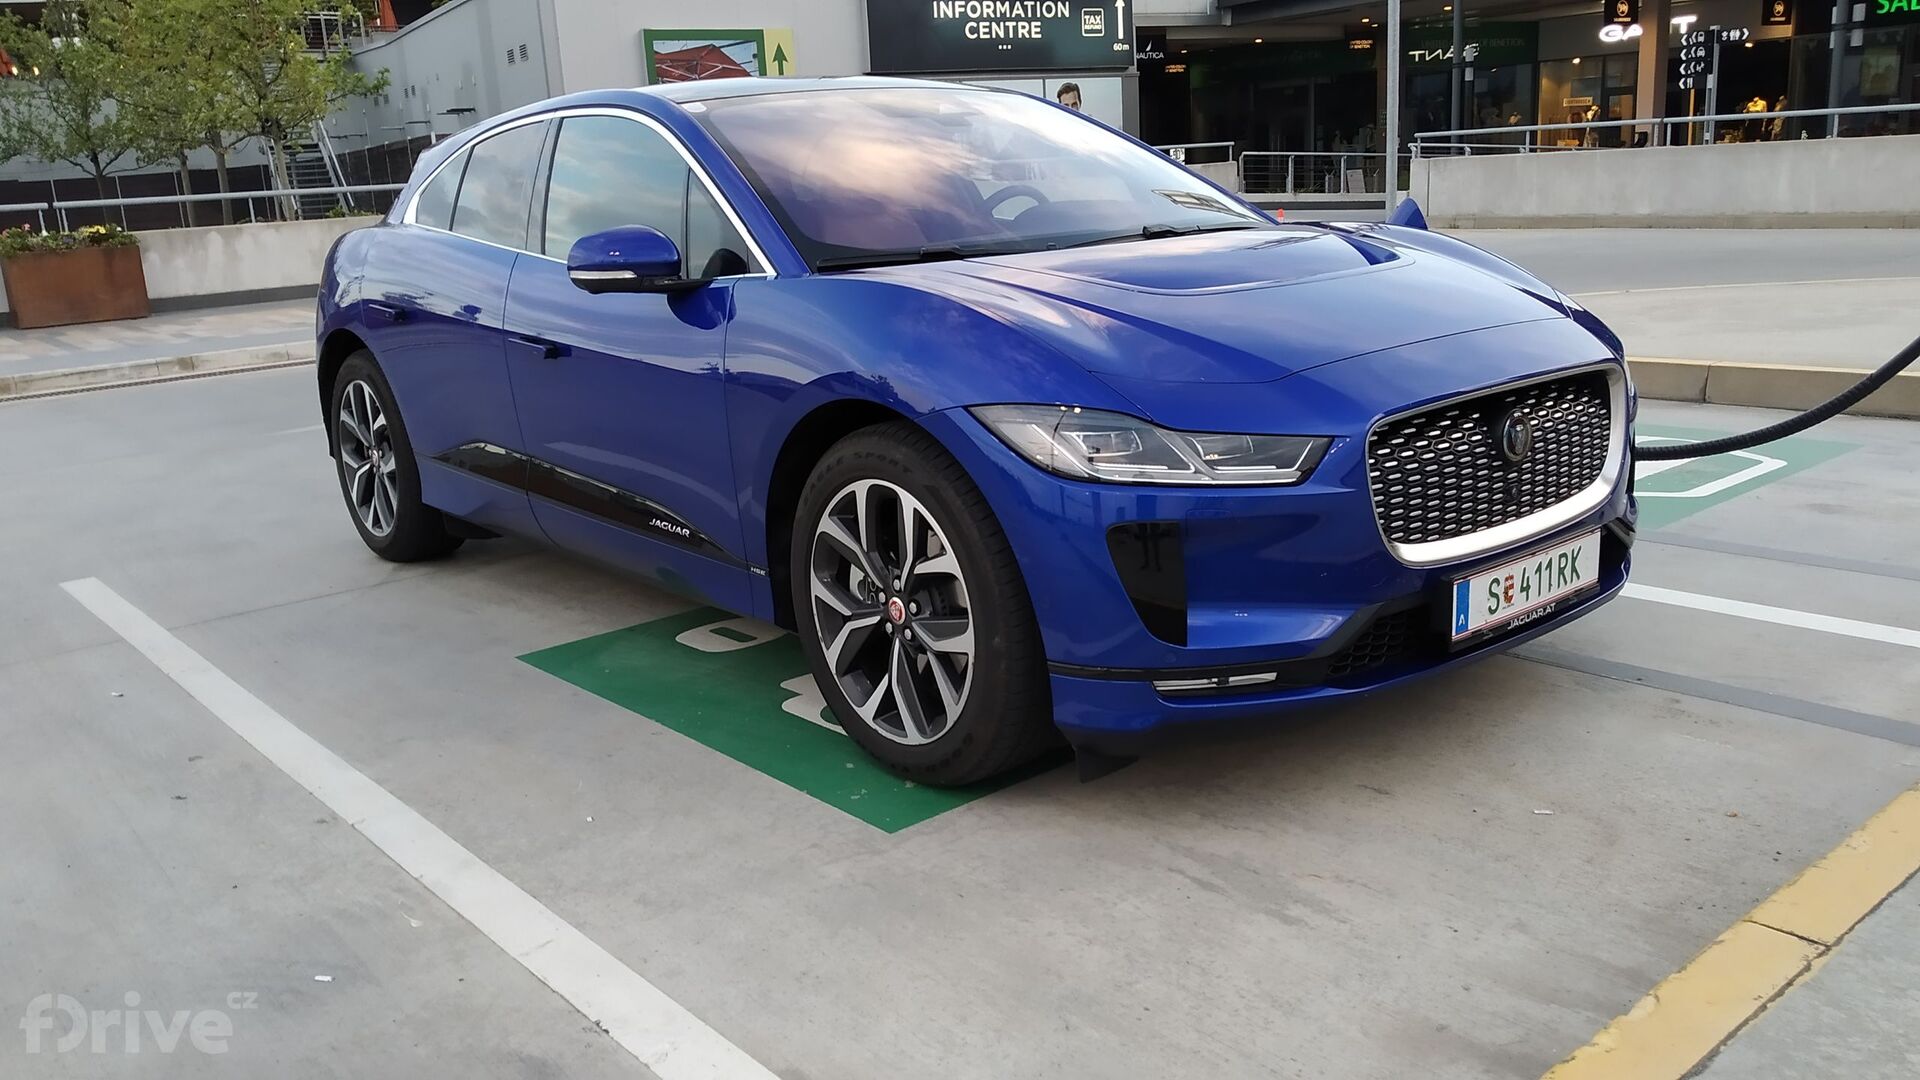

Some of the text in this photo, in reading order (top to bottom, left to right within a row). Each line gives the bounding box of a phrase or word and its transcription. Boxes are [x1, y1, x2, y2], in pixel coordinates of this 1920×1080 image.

[933, 1, 1070, 18] INFORMATION
[1084, 15, 1101, 24] TAX
[964, 21, 1042, 39] CENTRE
[649, 518, 690, 538] JAGUAR
[1458, 613, 1466, 626] A
[1507, 602, 1556, 630] JAGUAR.AT
